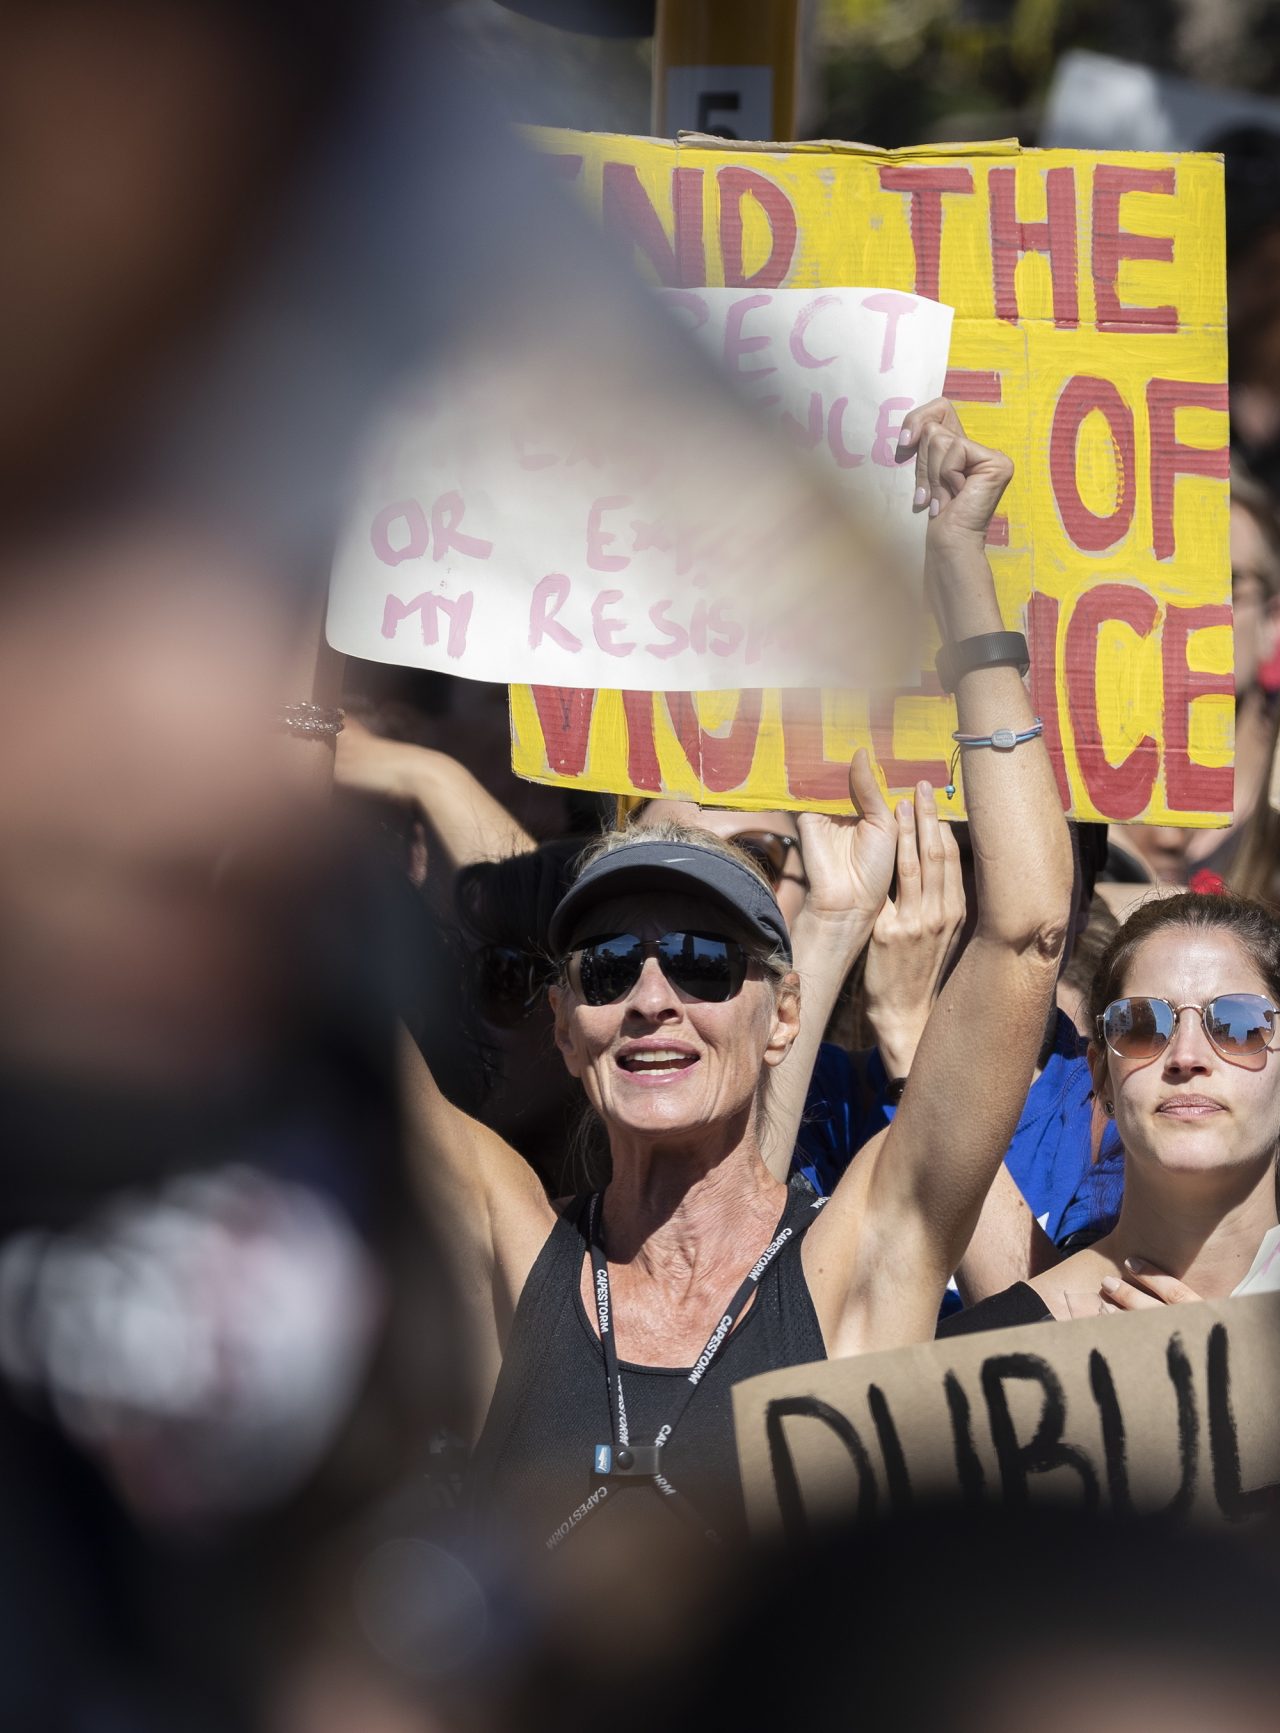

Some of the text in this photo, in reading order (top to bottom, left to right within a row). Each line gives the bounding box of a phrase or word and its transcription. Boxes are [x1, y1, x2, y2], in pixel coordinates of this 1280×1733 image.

[879, 163, 1179, 334] THE
[1050, 374, 1231, 561] OF
[371, 490, 493, 567] OR
[381, 591, 474, 658] MY
[747, 1227, 794, 1282] CAPESTORM
[596, 1268, 610, 1333] CAPESTORM
[687, 1315, 733, 1385] CAPESTORM
